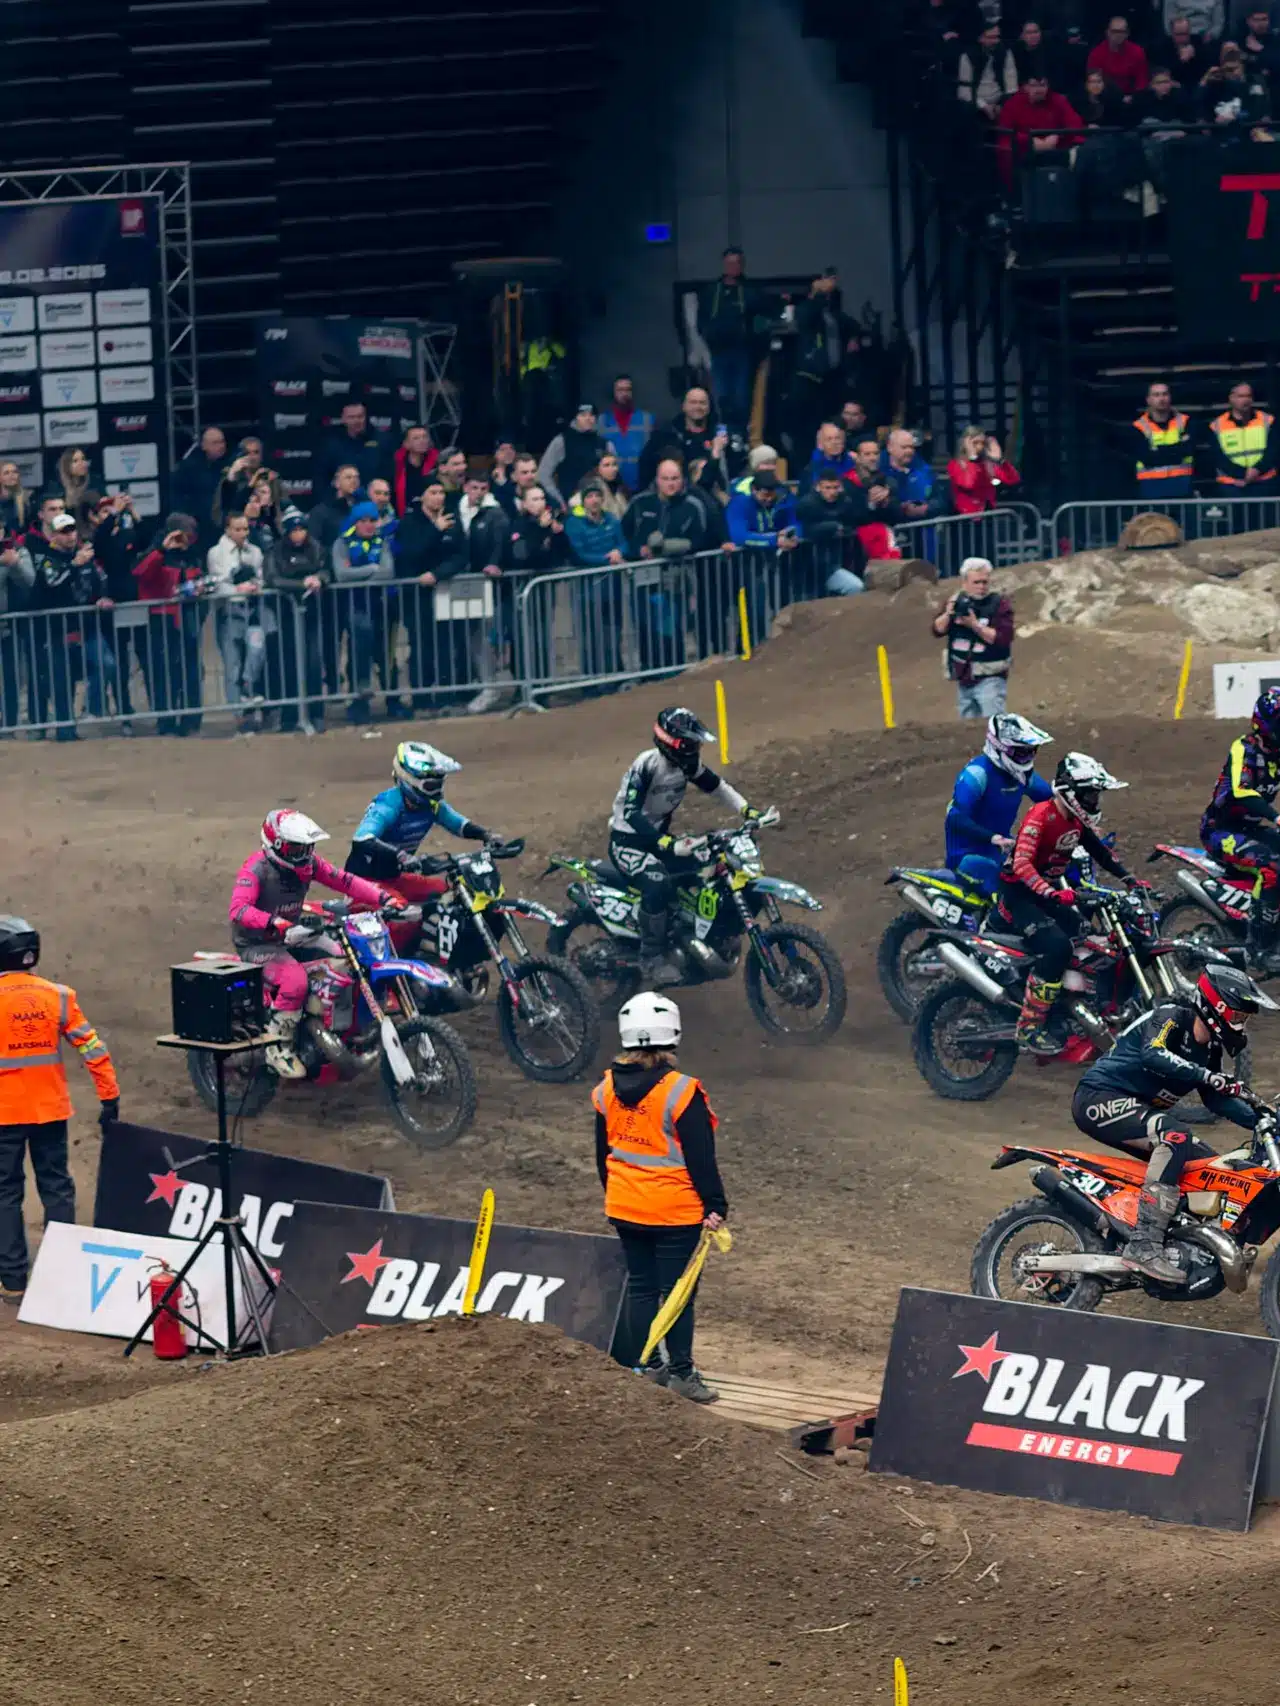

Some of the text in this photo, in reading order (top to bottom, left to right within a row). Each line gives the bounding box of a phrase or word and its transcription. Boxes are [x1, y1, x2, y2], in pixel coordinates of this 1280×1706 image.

[600, 897, 632, 922] 35
[982, 1352, 1205, 1442] BLACK
[1018, 1433, 1133, 1466] ENERGY
